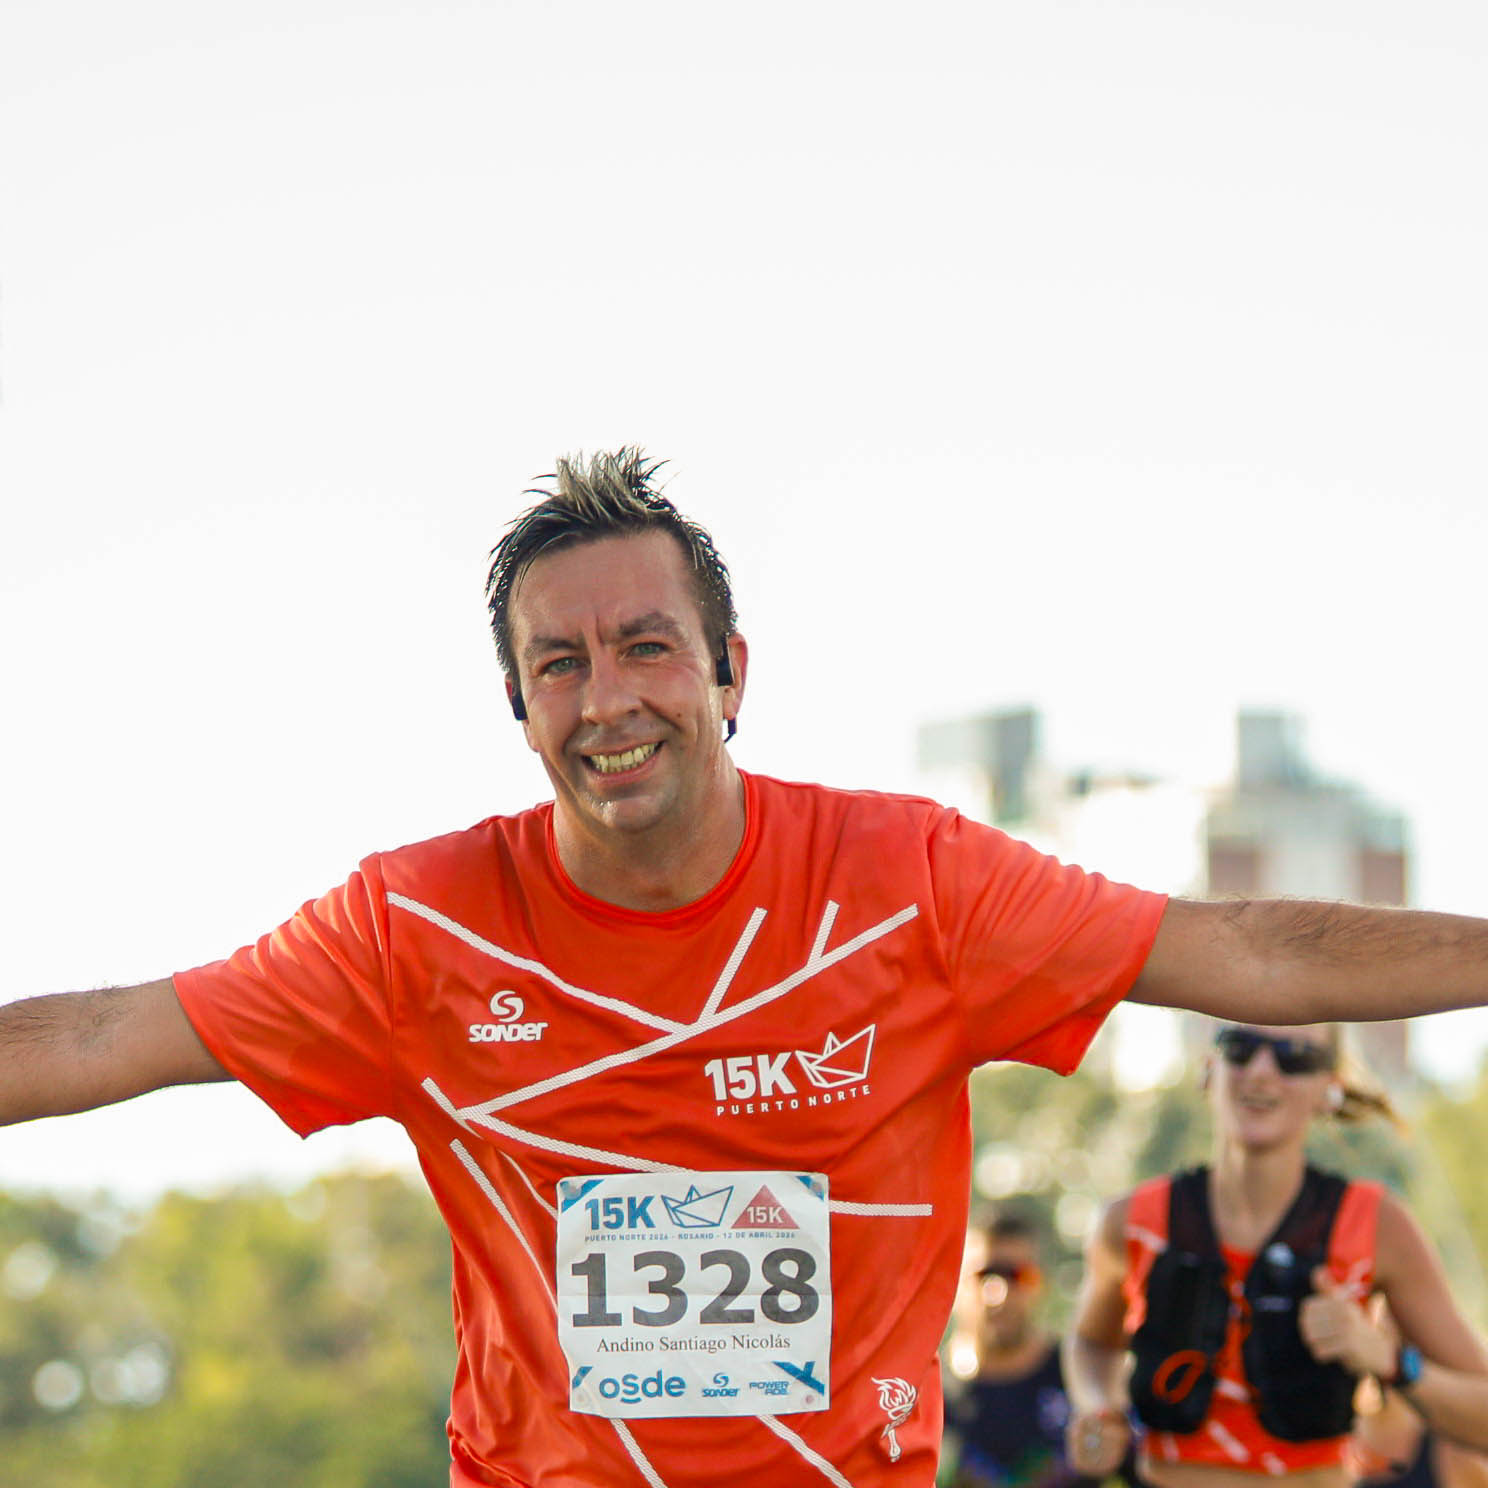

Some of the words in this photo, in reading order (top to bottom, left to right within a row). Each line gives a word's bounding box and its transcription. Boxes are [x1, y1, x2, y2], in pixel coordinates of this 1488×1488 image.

[704, 1051, 797, 1101] 15K
[716, 1099, 800, 1116] PUERTO
[808, 1084, 871, 1107] NORTE
[584, 1195, 656, 1231] 15K
[746, 1206, 784, 1224] 15K
[584, 1233, 617, 1242] PUERTO
[619, 1233, 647, 1241] NORTE
[677, 1232, 714, 1240] ROSARIO
[735, 1231, 746, 1239] DE
[748, 1231, 773, 1239] ABRIL
[571, 1248, 820, 1328] 1328
[597, 1337, 654, 1352] Andino
[659, 1336, 727, 1354] Santiago
[731, 1334, 791, 1350] Nicolás
[599, 1369, 686, 1400] osde
